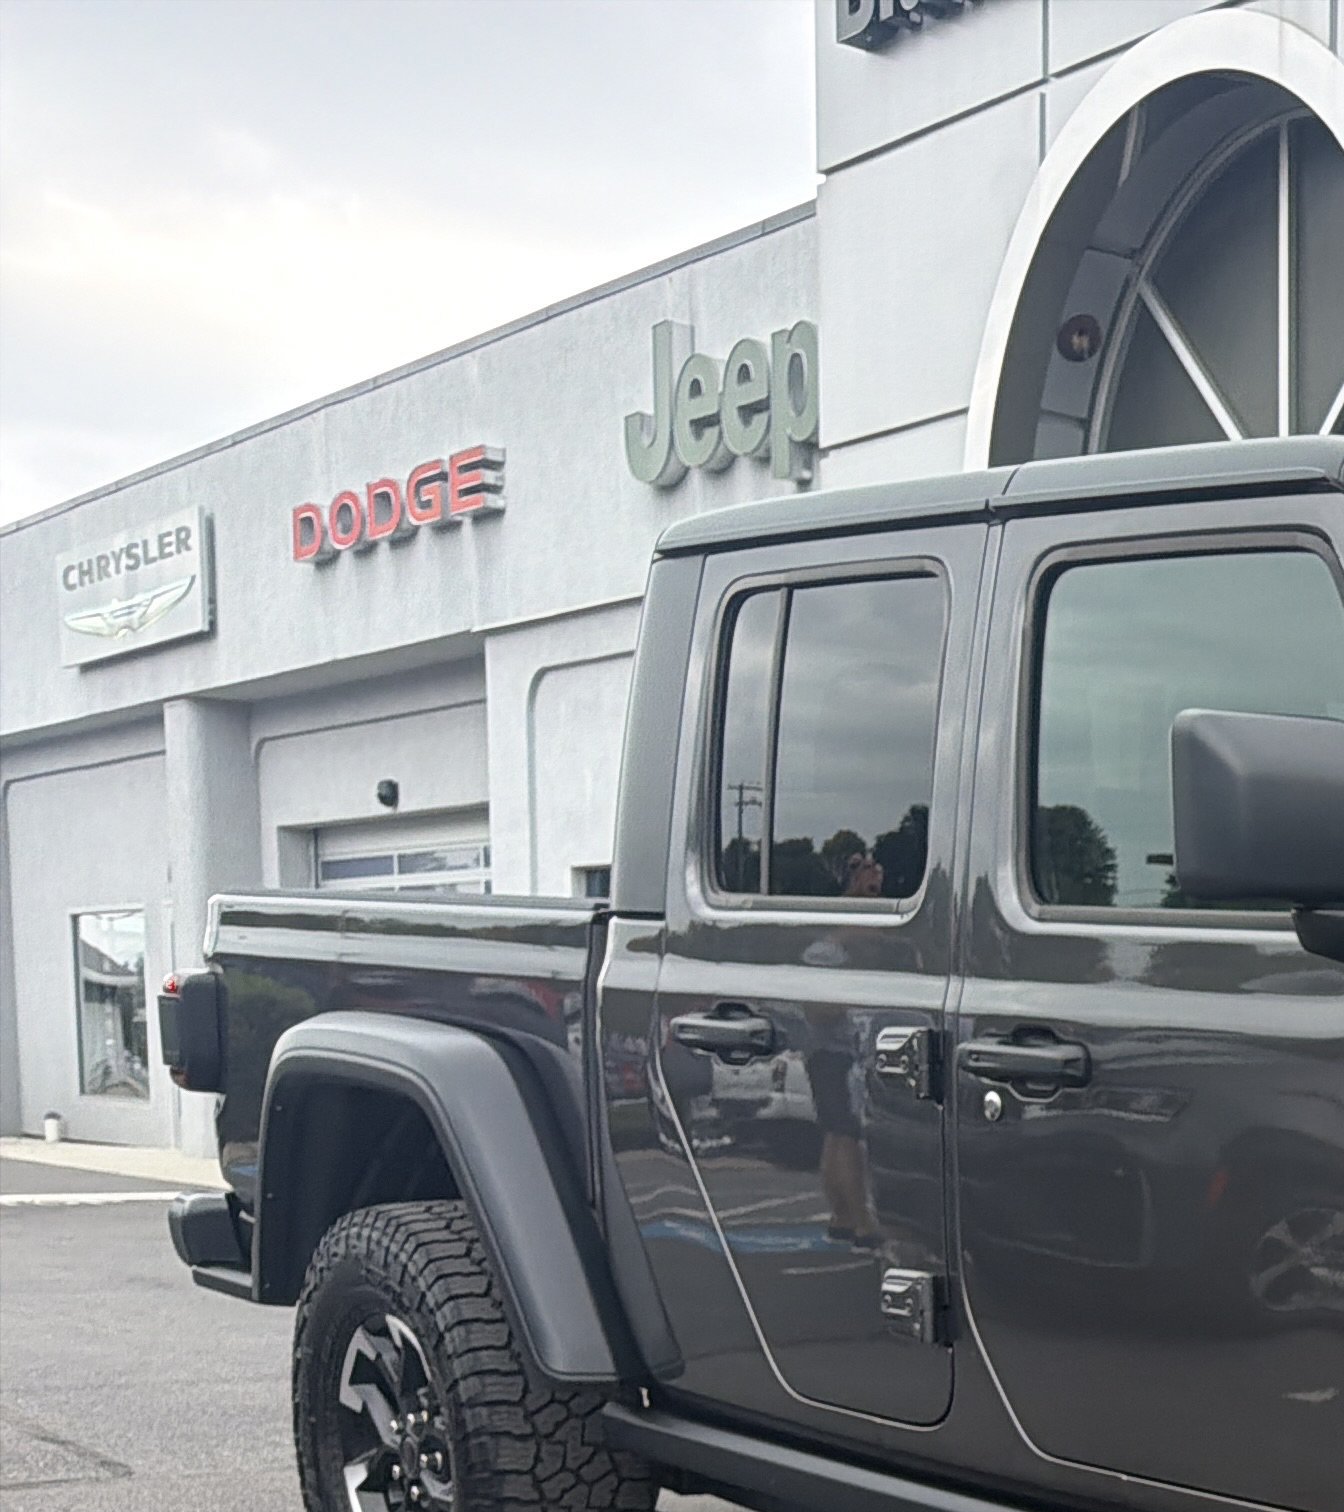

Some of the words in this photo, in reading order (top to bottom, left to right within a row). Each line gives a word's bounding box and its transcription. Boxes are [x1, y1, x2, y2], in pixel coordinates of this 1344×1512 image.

[625, 318, 819, 481] Jeep
[62, 525, 193, 592] CHRYSLER
[292, 444, 502, 562] DODGE
